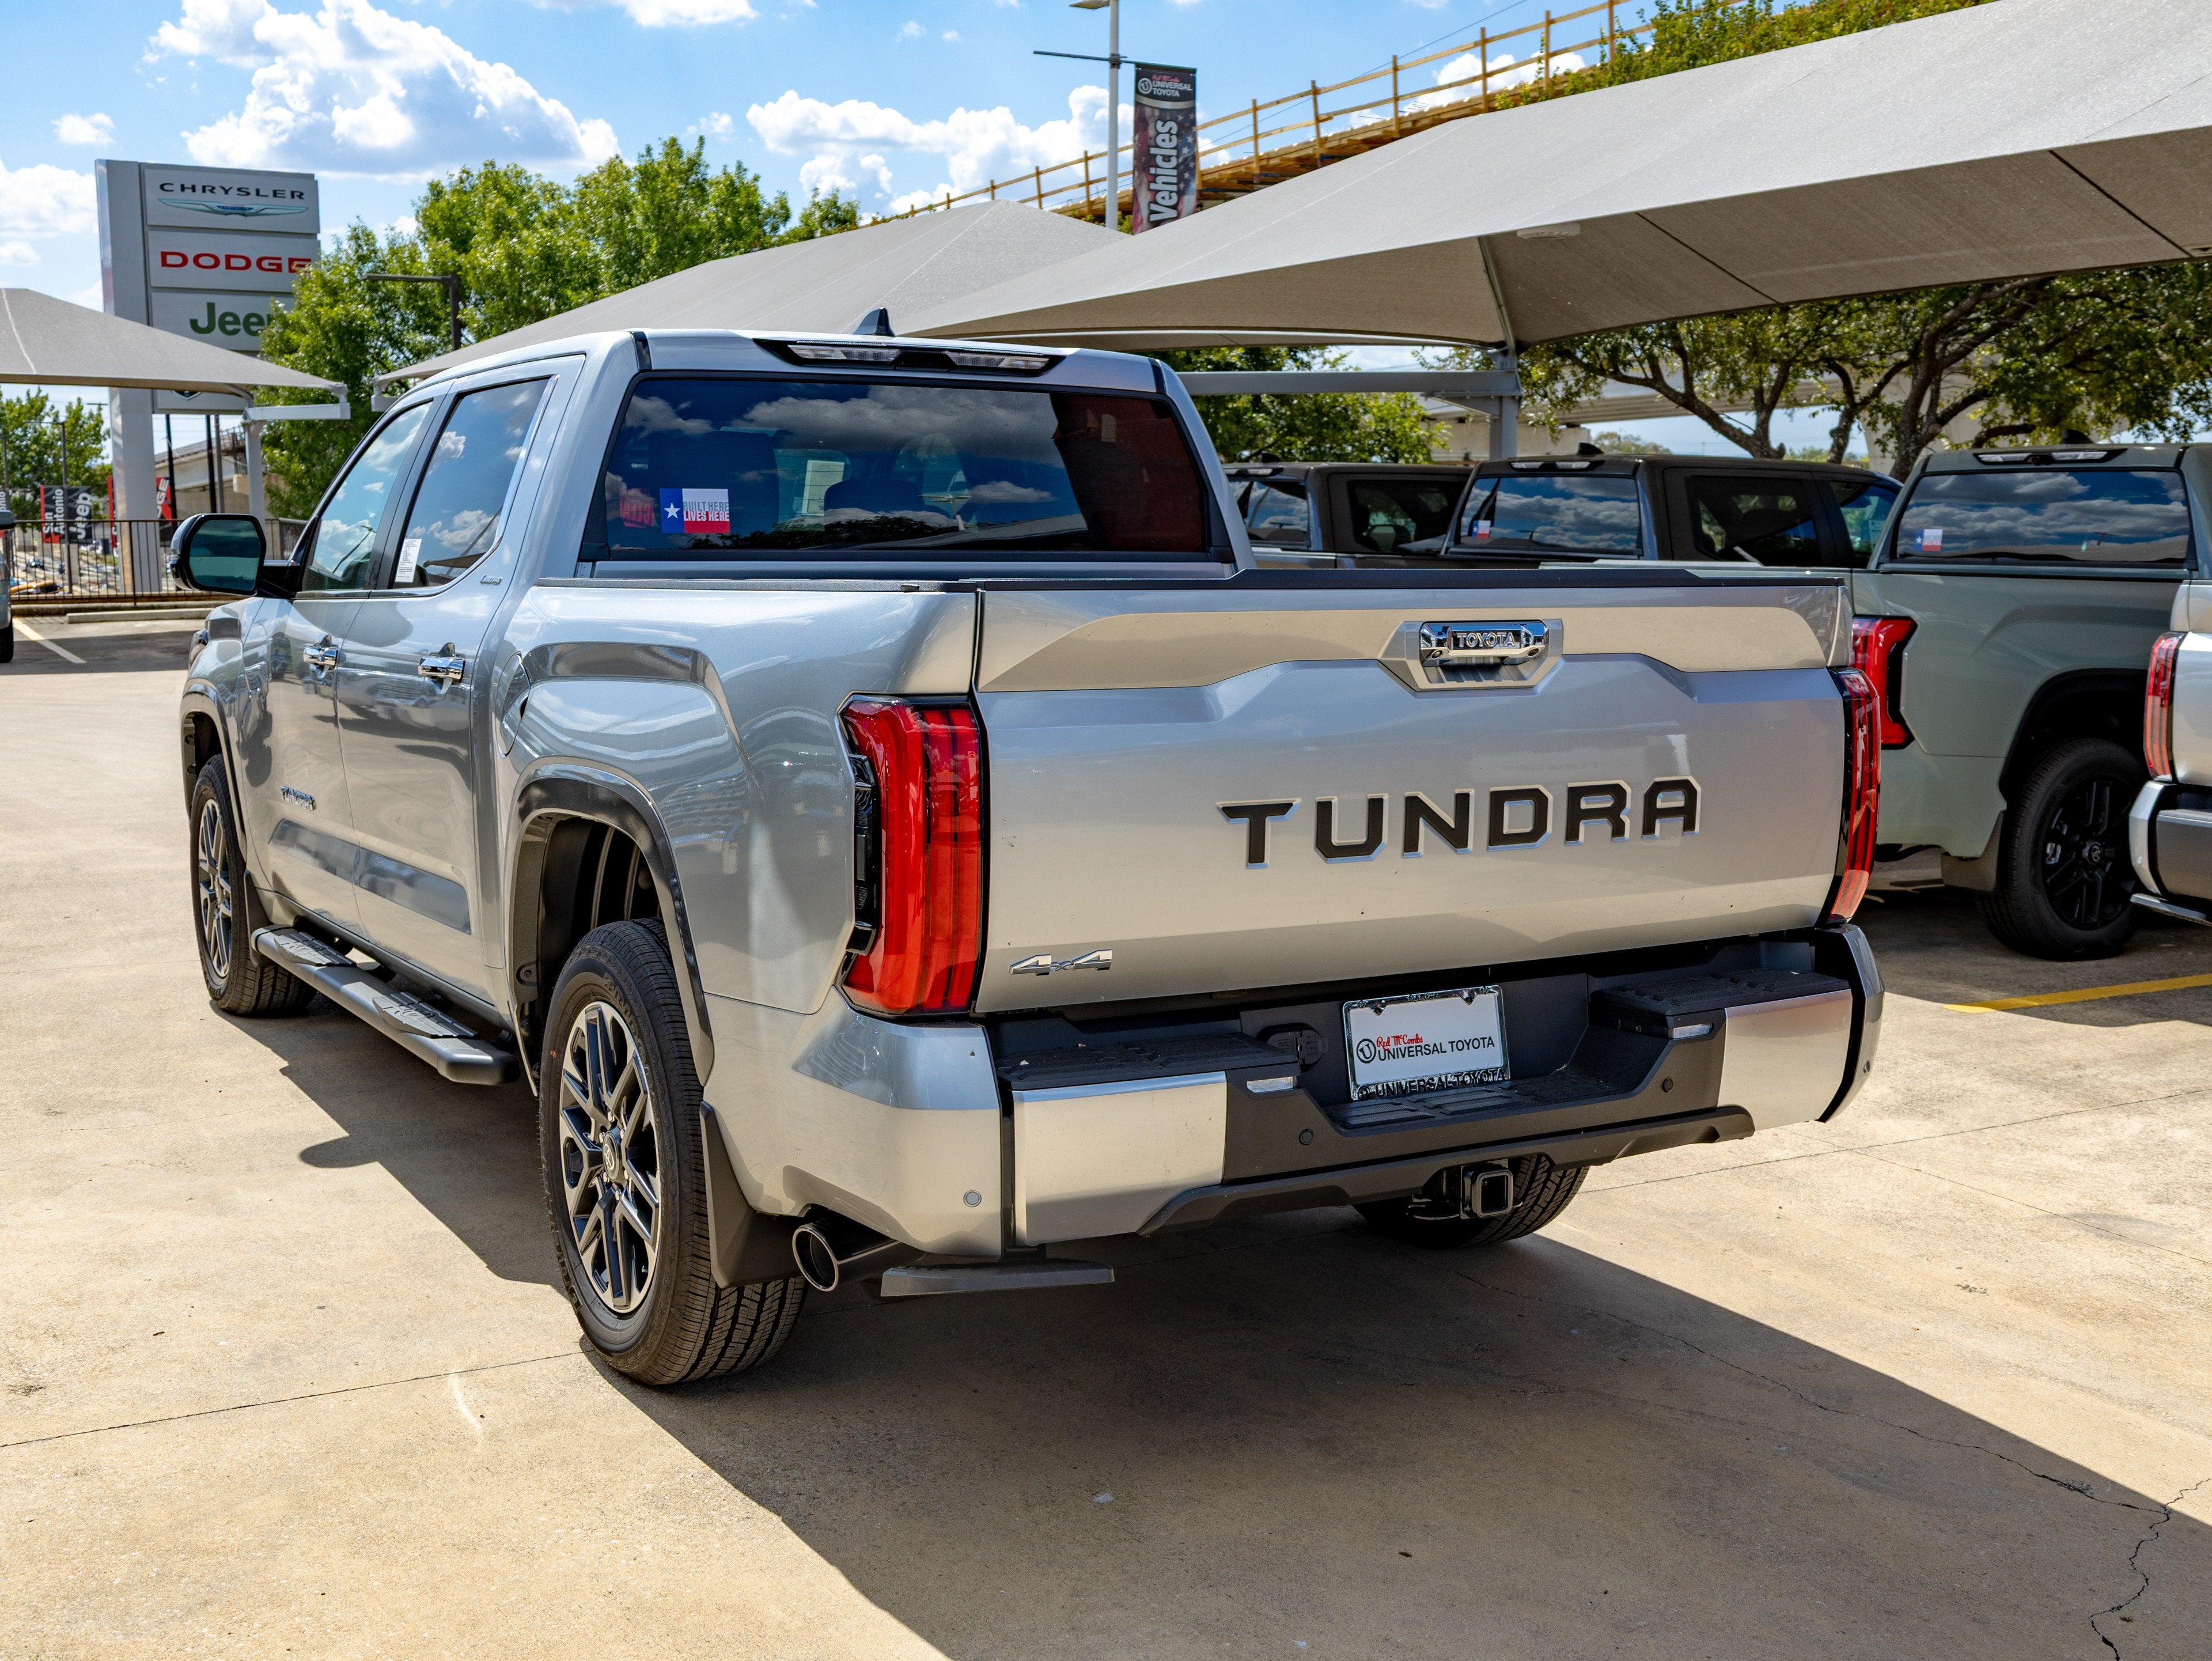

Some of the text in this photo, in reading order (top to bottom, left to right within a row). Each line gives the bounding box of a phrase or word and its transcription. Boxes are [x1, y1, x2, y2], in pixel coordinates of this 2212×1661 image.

[1153, 80, 1192, 91] UNIVERSAL
[1153, 88, 1180, 97] TOYOTA
[1150, 120, 1178, 221] Vehicles
[159, 183, 305, 200] CHRYSLER
[160, 251, 312, 273] DODGE
[190, 302, 274, 336] Jee
[53, 489, 64, 535] Antonio
[69, 492, 92, 539] Jeep
[683, 501, 729, 512] BUILT HERE
[684, 511, 730, 521] LIVES HERE
[1457, 632, 1516, 648] TOYOTA
[1217, 776, 1702, 869] TUNDRA
[1376, 1036, 1391, 1051] Red
[1378, 1042, 1446, 1061] UNIVERSAL
[1448, 1036, 1495, 1052] TOYOTA
[1375, 1068, 1505, 1098] UNIVERSAL TOYOTA
